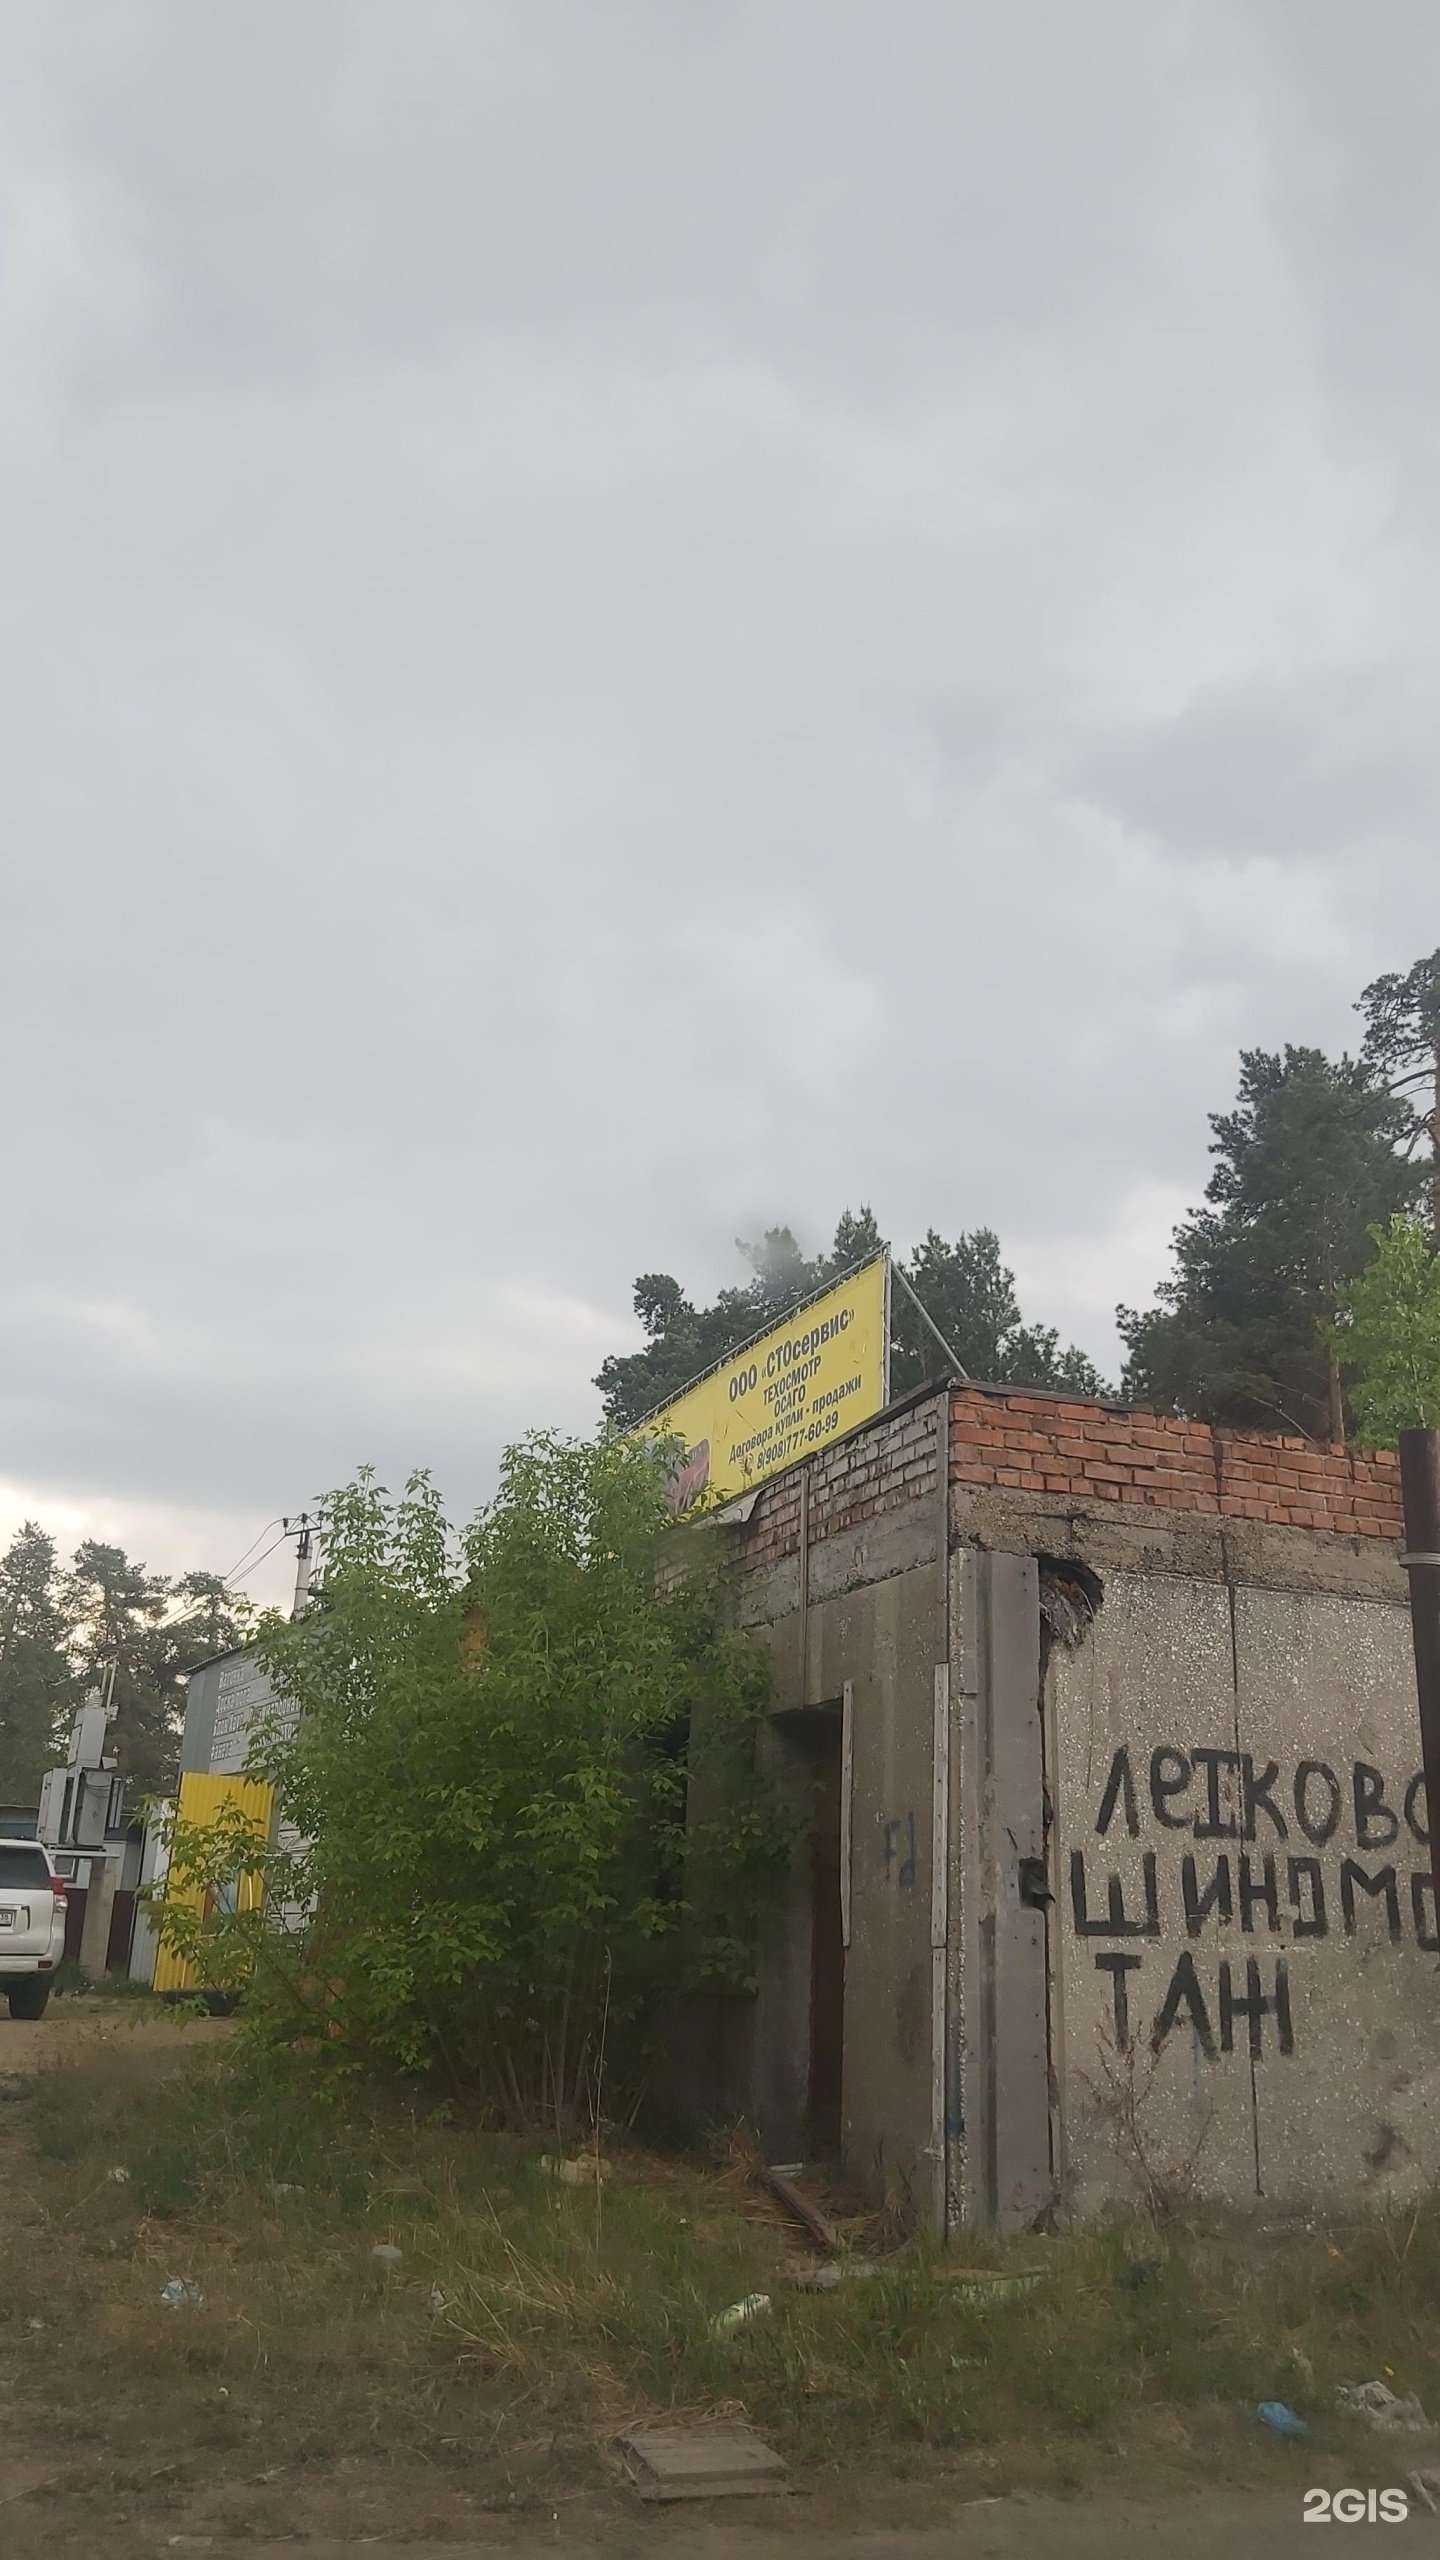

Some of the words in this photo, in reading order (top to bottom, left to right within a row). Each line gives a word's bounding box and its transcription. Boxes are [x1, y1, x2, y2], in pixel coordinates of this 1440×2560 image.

[729, 1363, 758, 1403] ООО
[763, 1355, 822, 1406] ТЕХОСМОТР
[774, 1384, 806, 1418] ОСАГО
[728, 1425, 773, 1465] Договора
[775, 1407, 803, 1436] купли
[812, 1373, 862, 1416] продажи
[756, 1410, 839, 1471] 8(908)777-60-99
